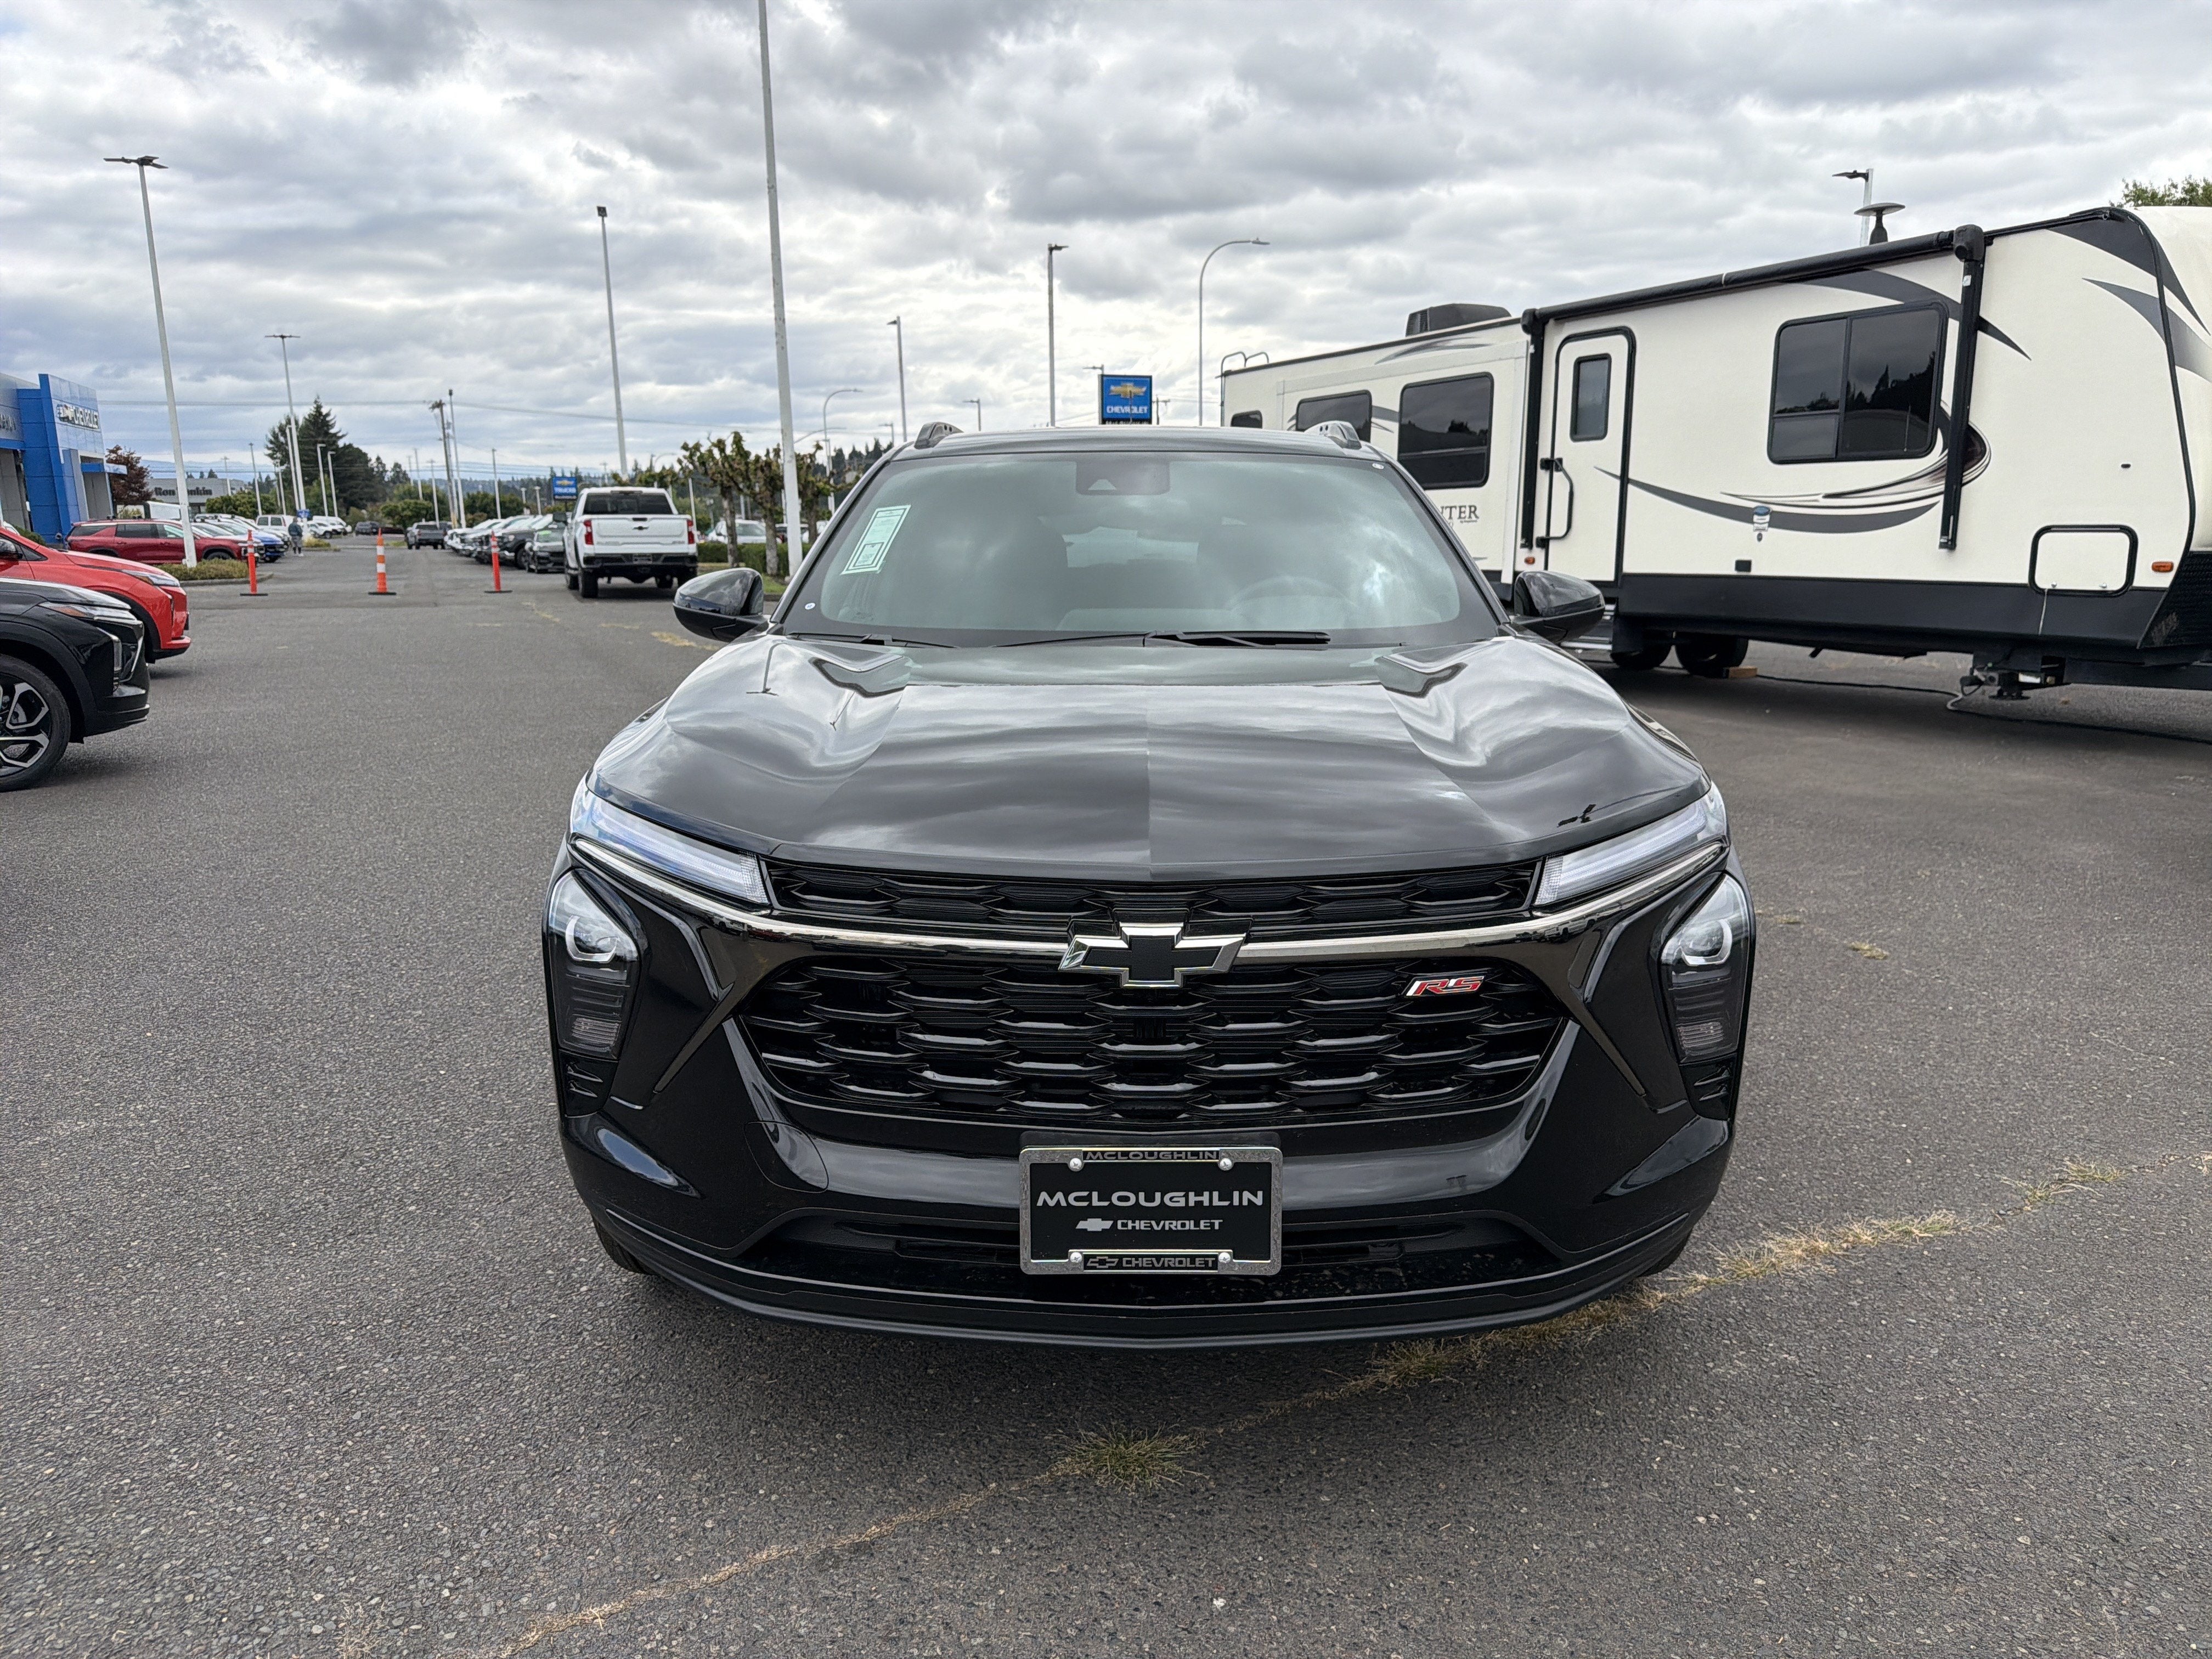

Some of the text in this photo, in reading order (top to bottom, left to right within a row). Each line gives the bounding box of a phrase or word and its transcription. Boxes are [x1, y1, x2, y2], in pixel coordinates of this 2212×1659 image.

[1106, 405, 1148, 414] CHEVROLET
[1406, 975, 1485, 996] RS
[1086, 1151, 1217, 1160] MCLOUGHLIN
[1036, 1190, 1263, 1207] MCLOUGHLIN
[1117, 1219, 1223, 1231] CHEVROLET
[1122, 1257, 1216, 1267] CHEVROLET
